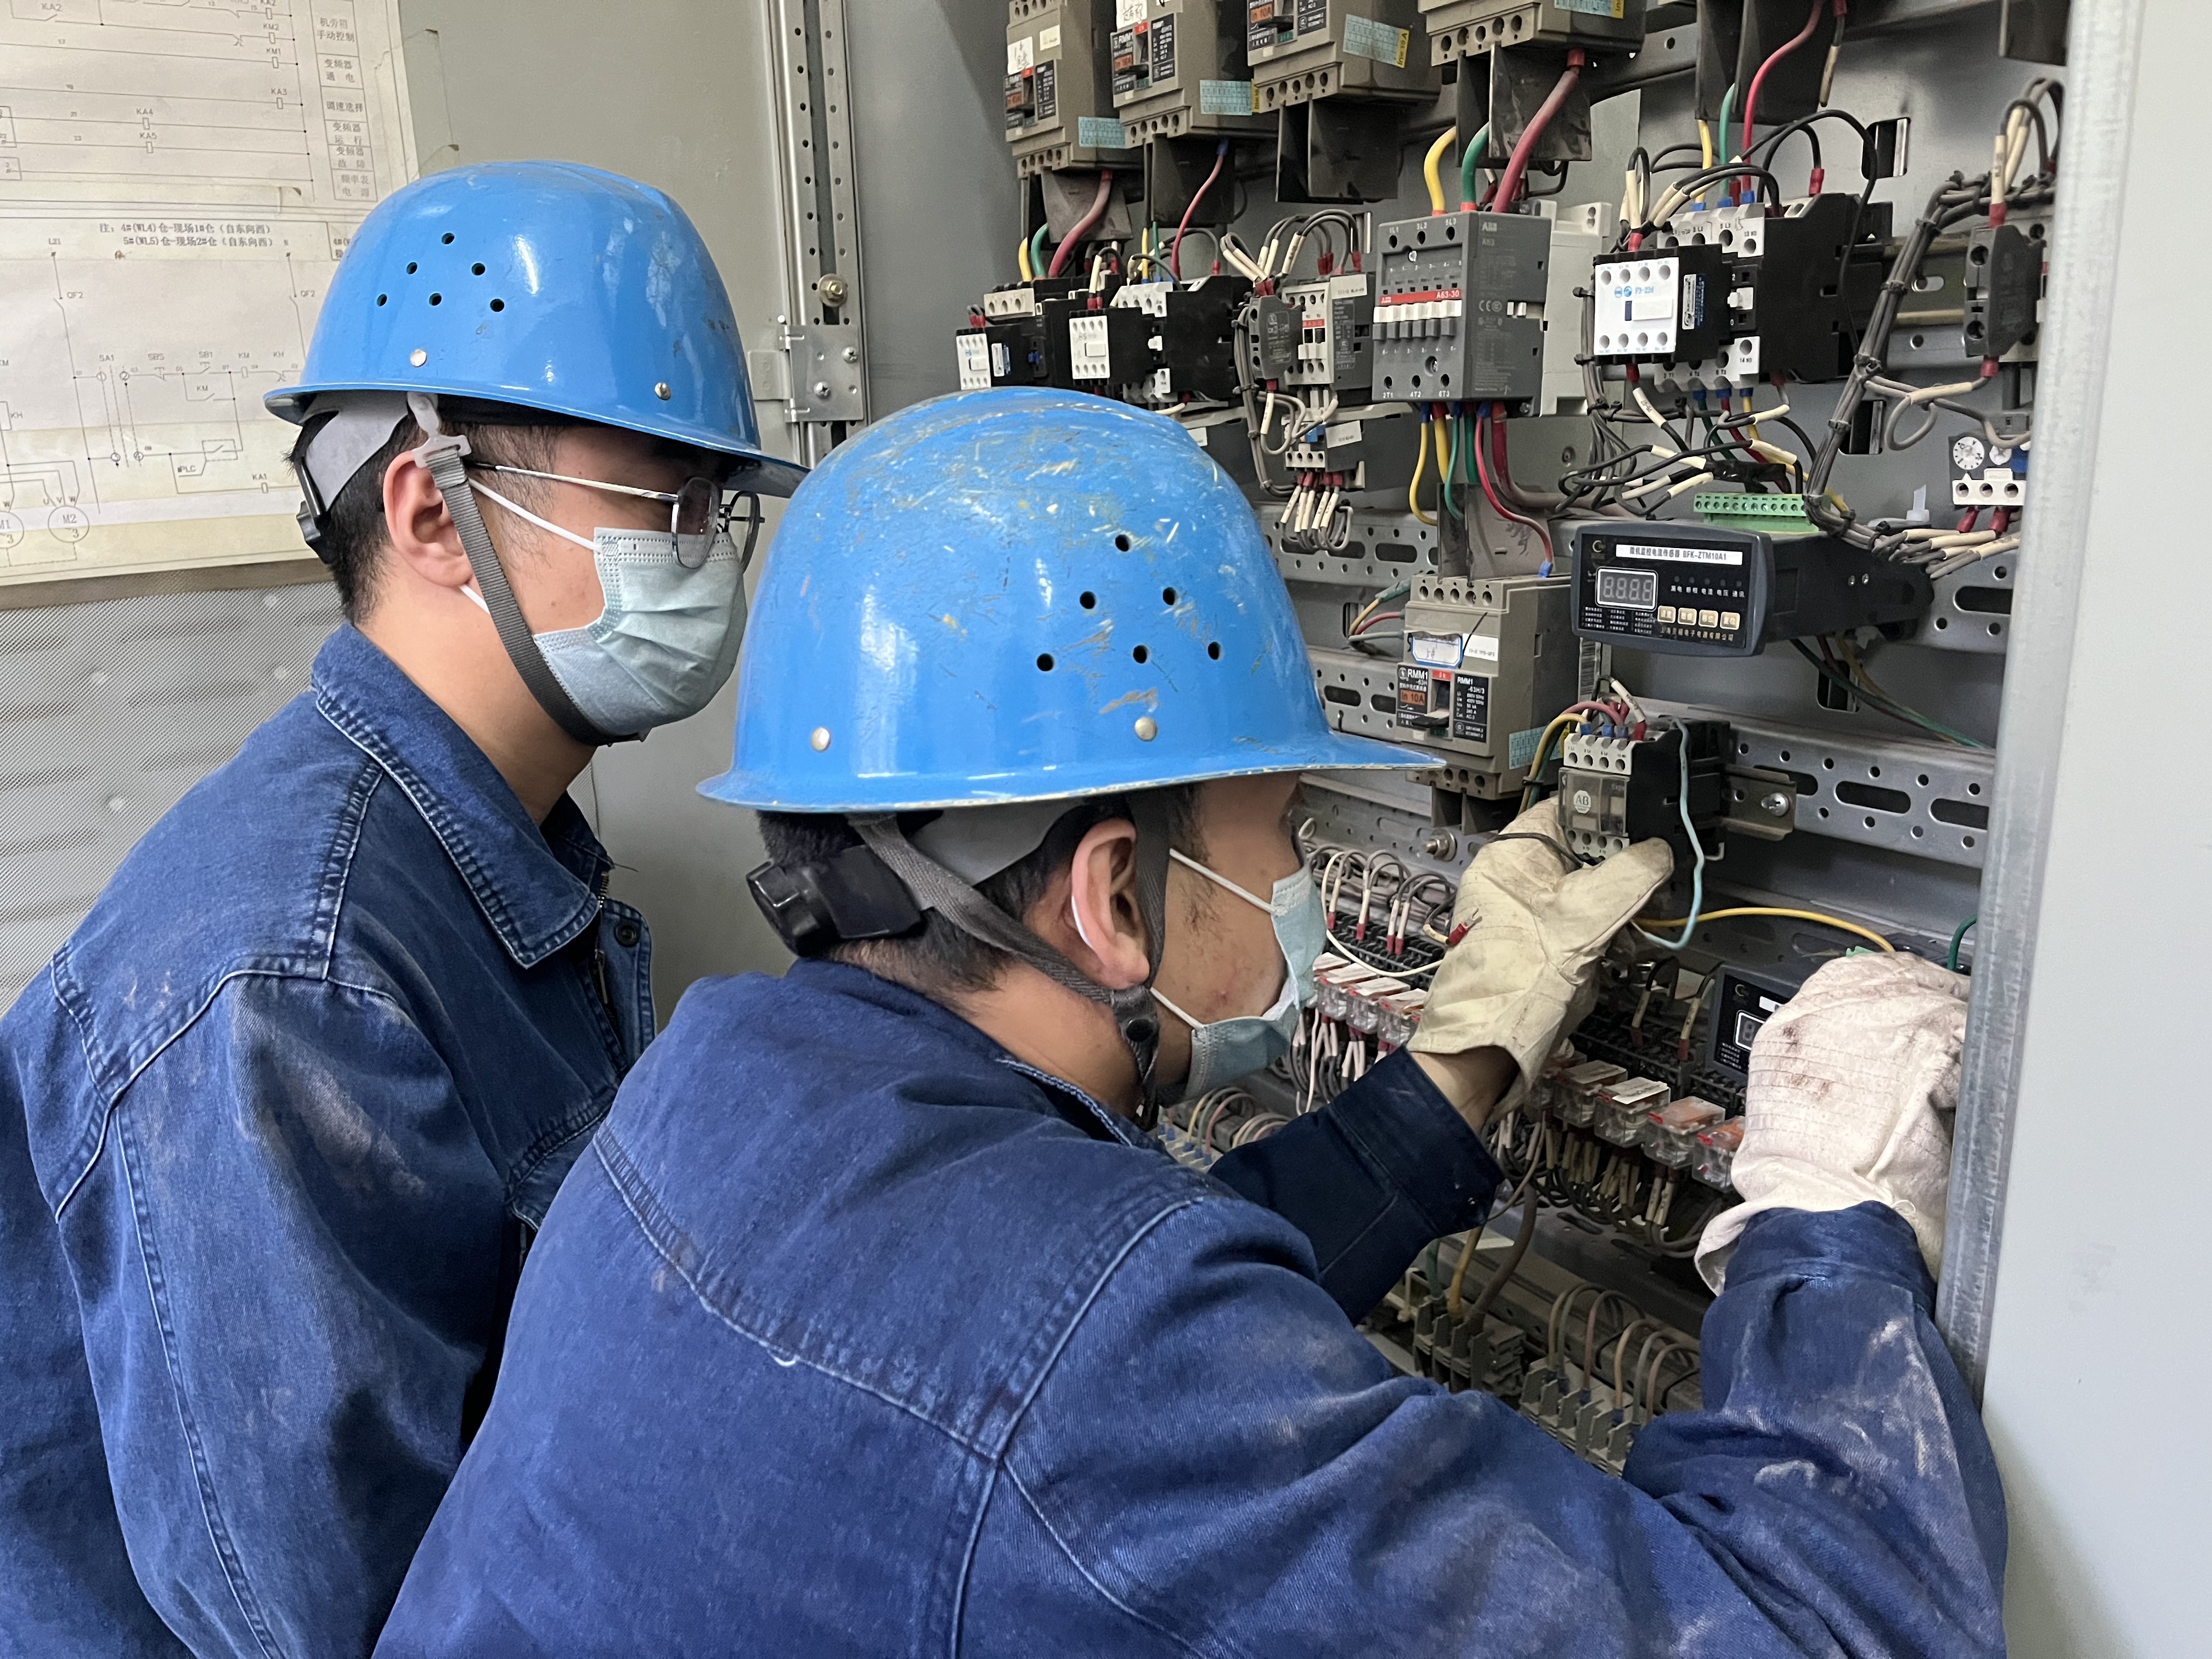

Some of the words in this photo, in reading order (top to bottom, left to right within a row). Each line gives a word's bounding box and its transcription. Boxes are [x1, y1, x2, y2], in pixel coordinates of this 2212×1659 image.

[1482, 222, 1497, 232] ABB
[1436, 290, 1459, 299] A63-30
[63, 514, 77, 524] M2
[1683, 550, 1726, 561] BFK-ZTM10A1
[1407, 668, 1428, 680] RMM1
[1457, 676, 1473, 685] RMM1
[1411, 693, 1425, 703] 10A
[1576, 795, 1589, 805] AB
